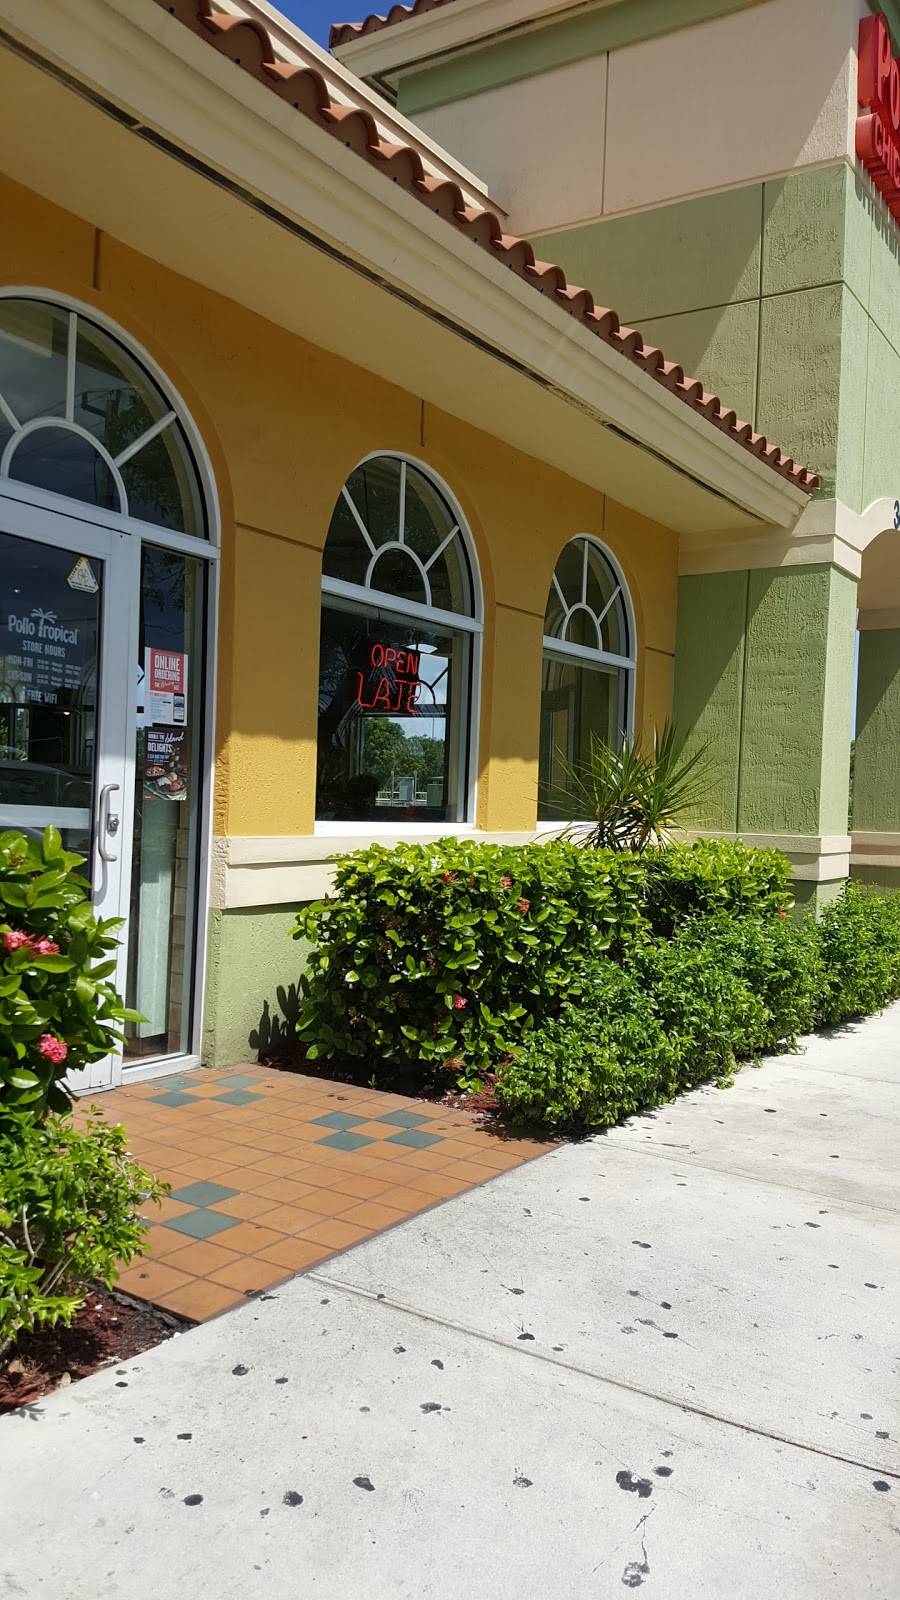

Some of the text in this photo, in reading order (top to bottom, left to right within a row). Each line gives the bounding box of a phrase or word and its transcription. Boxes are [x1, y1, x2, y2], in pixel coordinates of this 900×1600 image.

[8, 608, 78, 645] Pollo Tropical
[22, 641, 66, 658] STORE HOURS
[154, 654, 181, 672] ONLINE
[371, 643, 419, 675] OPEN
[154, 668, 181, 682] ORDERING
[26, 690, 43, 702] FREE
[357, 671, 420, 713] LATE
[165, 731, 185, 744] Island
[147, 742, 173, 753] DELIGHTS
